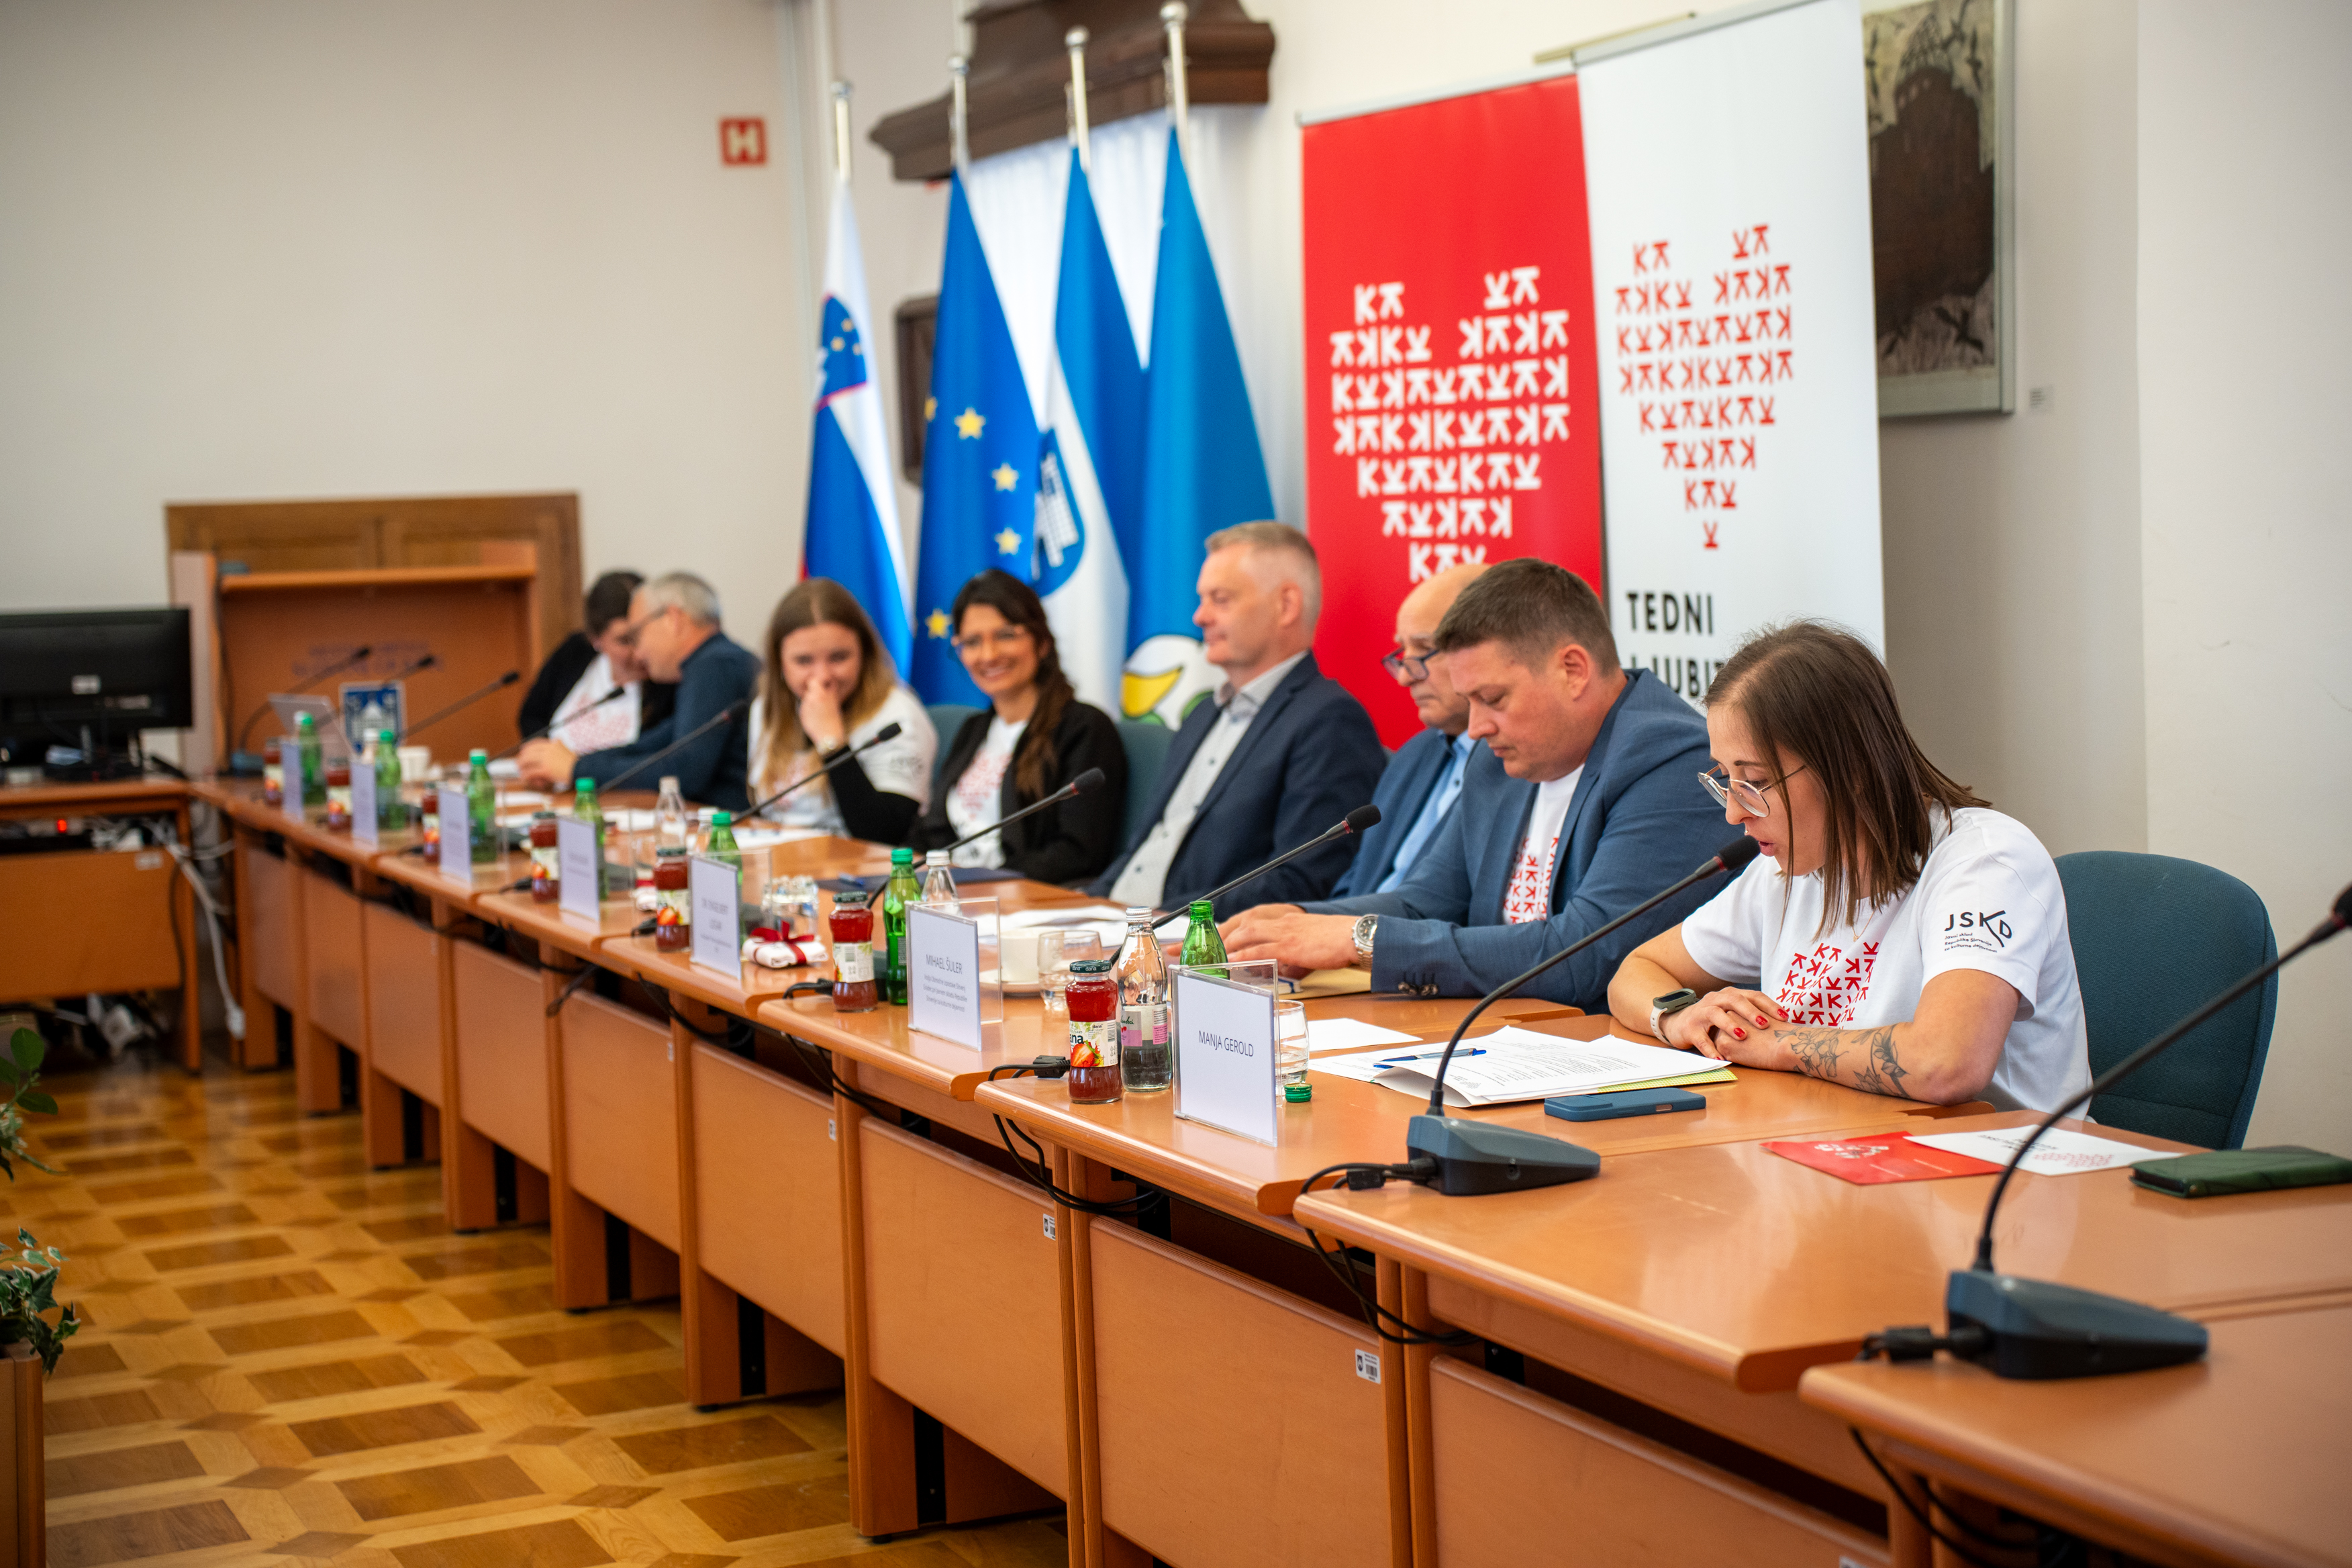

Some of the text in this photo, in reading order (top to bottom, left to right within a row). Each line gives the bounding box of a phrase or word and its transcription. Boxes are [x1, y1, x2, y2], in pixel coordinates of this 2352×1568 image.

[1627, 593, 1714, 634] TEDNI
[1944, 910, 2012, 948] JSKD
[926, 954, 963, 975] MIHAEL ŠULER
[1199, 1030, 1254, 1057] MANJA GEROLD
